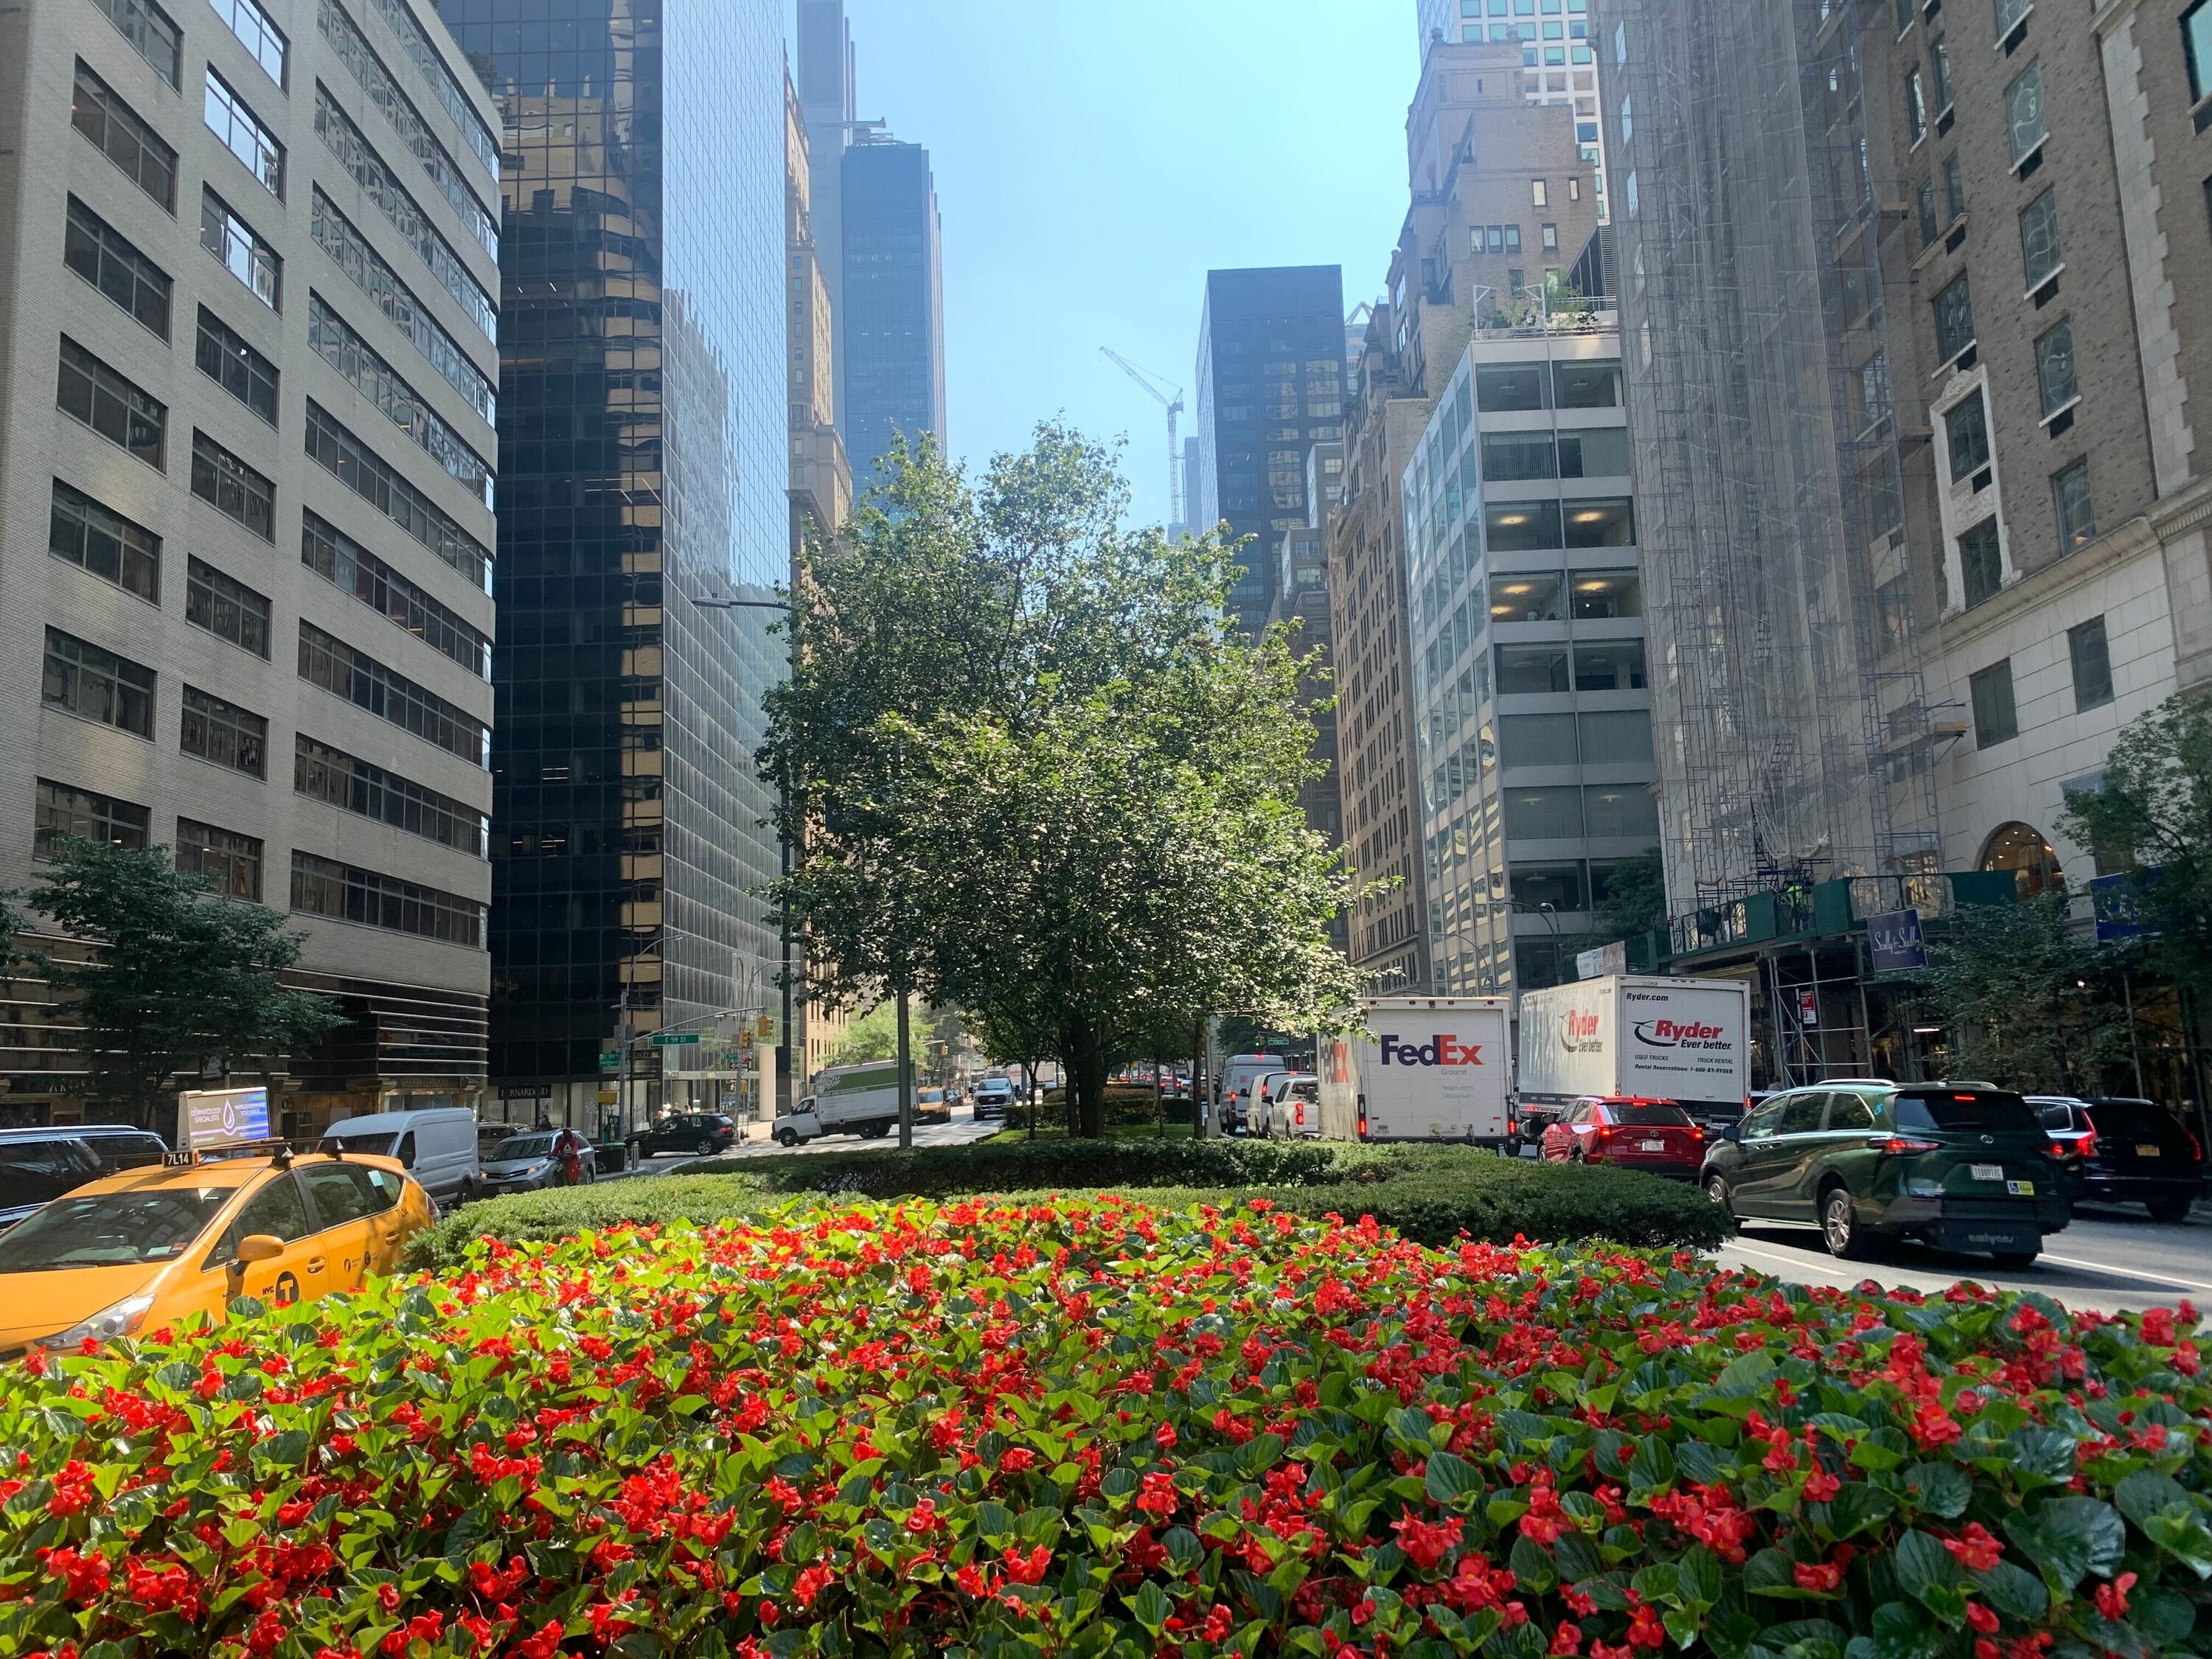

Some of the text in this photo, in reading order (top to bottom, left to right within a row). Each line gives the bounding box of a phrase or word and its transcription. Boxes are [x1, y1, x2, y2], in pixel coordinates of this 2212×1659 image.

[1627, 992, 1669, 1001] Ryder.com
[1569, 1009, 1599, 1043] Ryder
[1655, 1020, 1724, 1041] Ryder
[1381, 1034, 1484, 1066] FedEx
[1681, 1040, 1732, 1050] Ever better.
[191, 1107, 221, 1117] DERMATOLOGY
[195, 1114, 220, 1123] SPECIALISTS
[167, 1153, 189, 1165] 7L14
[262, 1285, 274, 1295] NYC
